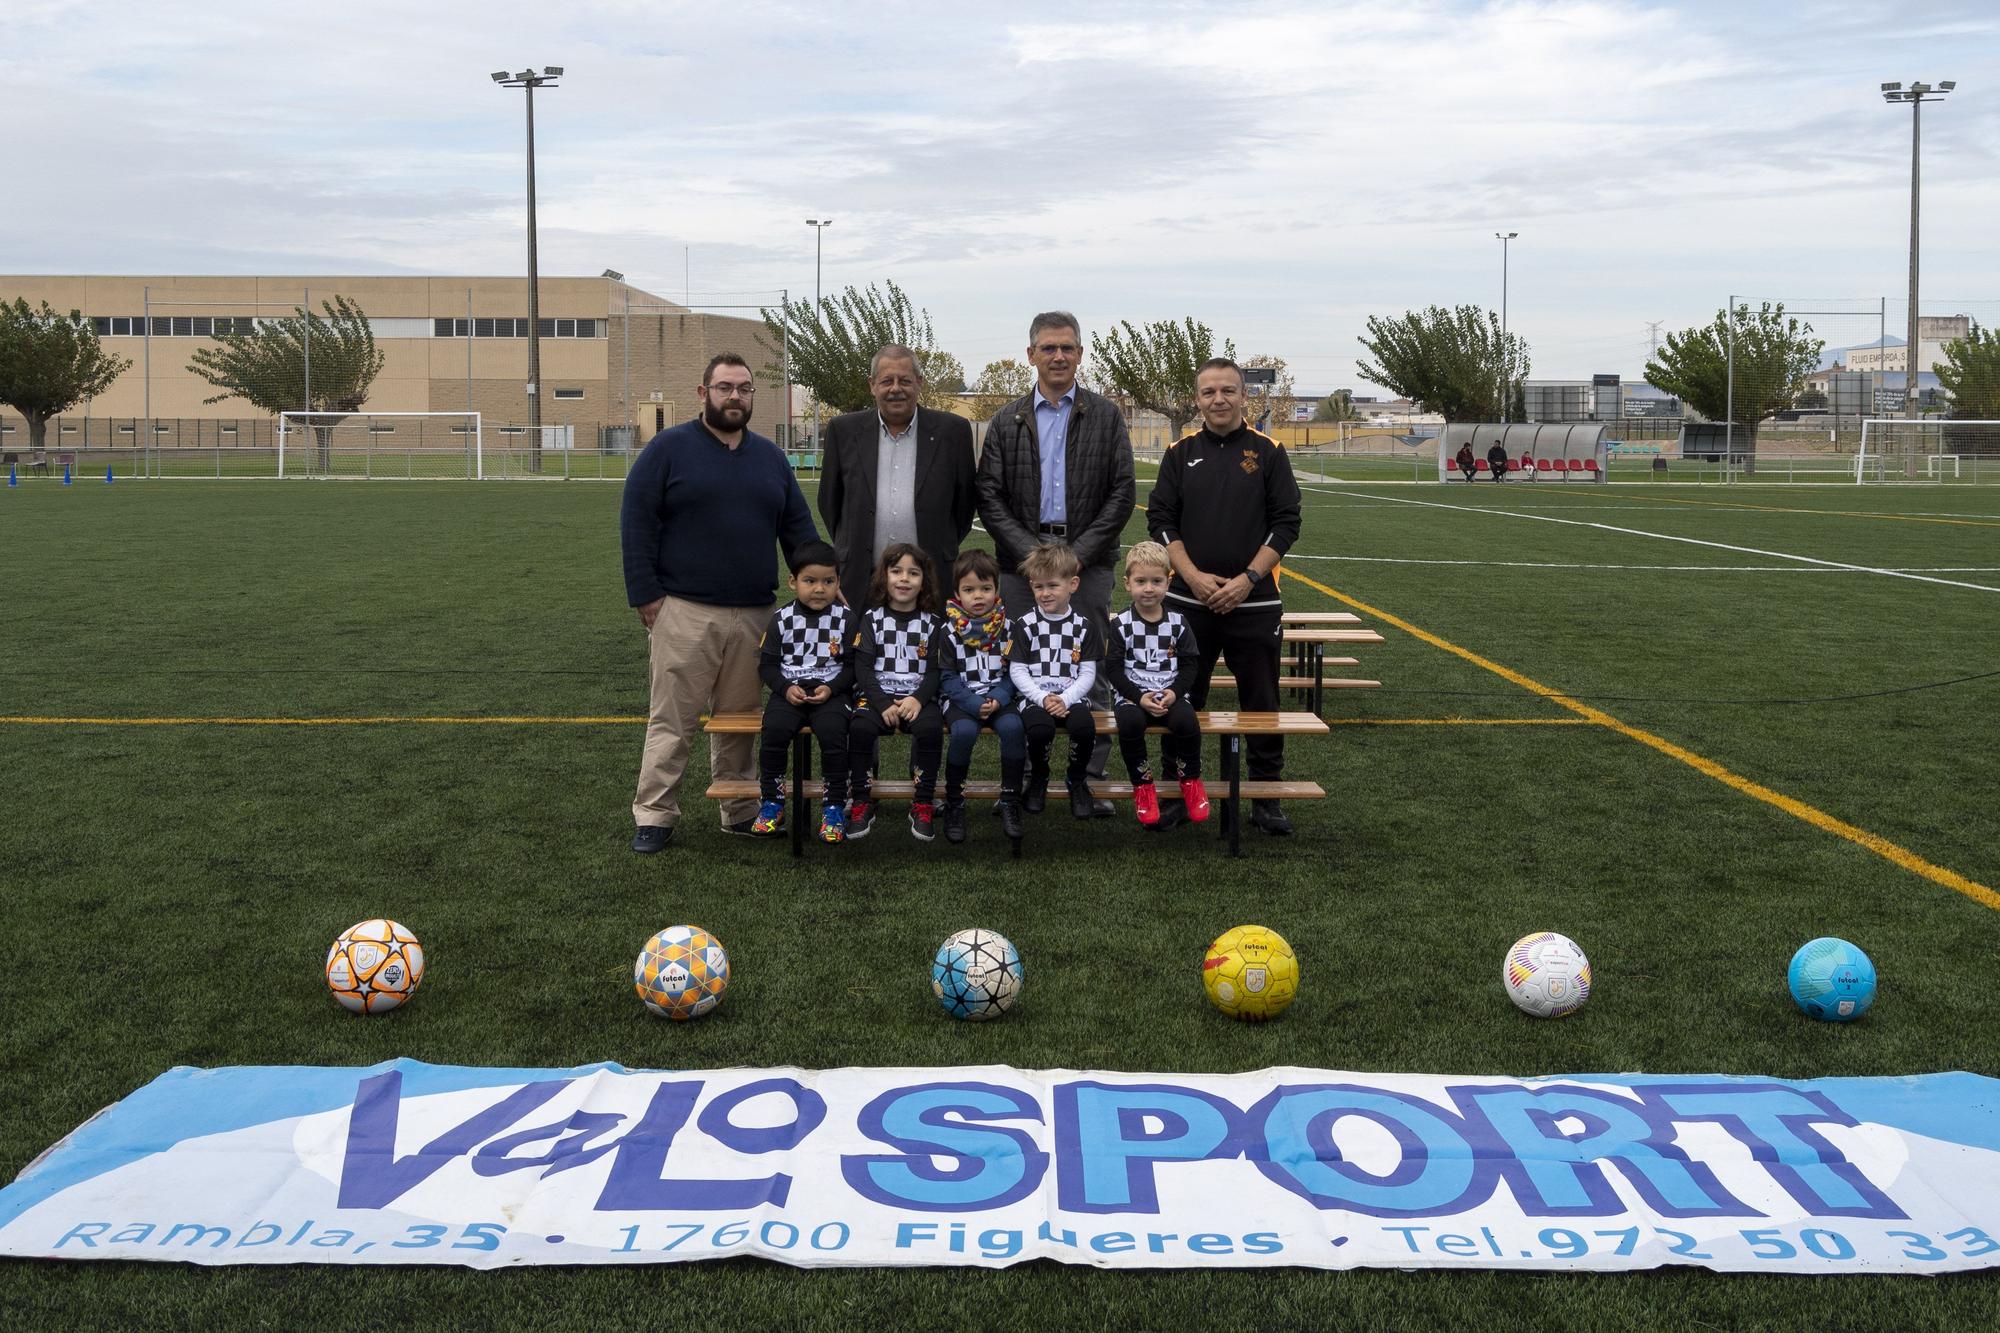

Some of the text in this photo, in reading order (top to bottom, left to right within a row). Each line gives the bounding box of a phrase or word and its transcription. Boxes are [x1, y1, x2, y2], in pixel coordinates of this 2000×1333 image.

[1851, 354, 1868, 364] FLUID
[804, 640, 817, 658] 2
[895, 643, 908, 660] 10
[1144, 647, 1160, 664] 14
[976, 652, 990, 670] 11
[662, 973, 687, 983] futcat
[841, 1080, 1908, 1220] SPORT
[53, 1221, 372, 1255] Rambla,
[391, 1222, 508, 1253] 35
[610, 1220, 851, 1253] 17600
[895, 1222, 1285, 1259] Figueres
[1738, 1228, 1858, 1261] 50
[1885, 1226, 2000, 1262] 33
